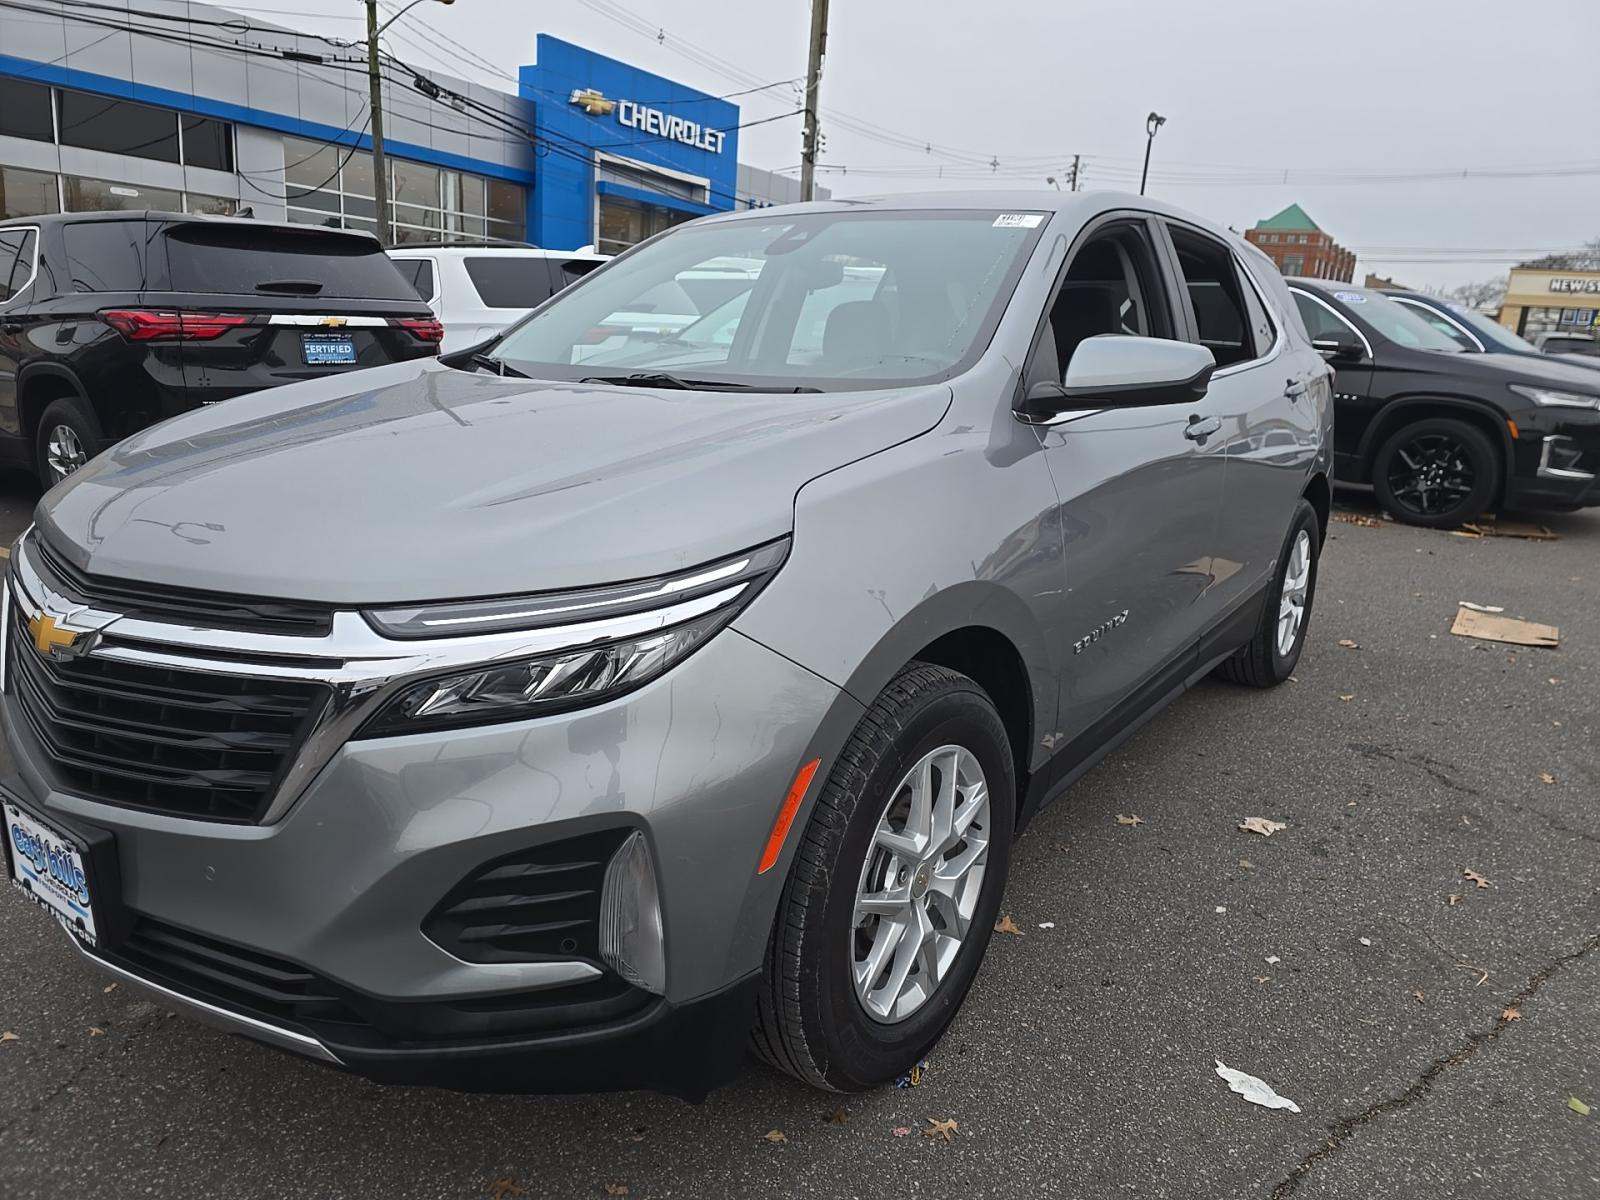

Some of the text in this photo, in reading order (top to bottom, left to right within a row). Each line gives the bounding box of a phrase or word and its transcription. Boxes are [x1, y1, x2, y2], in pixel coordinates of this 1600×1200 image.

[618, 100, 726, 154] CHEVROLET
[1550, 279, 1583, 293] NEW
[305, 344, 352, 354] CERTIFIED
[11, 823, 48, 875] east
[44, 839, 90, 909] hills
[50, 906, 97, 948] FREEPORT
